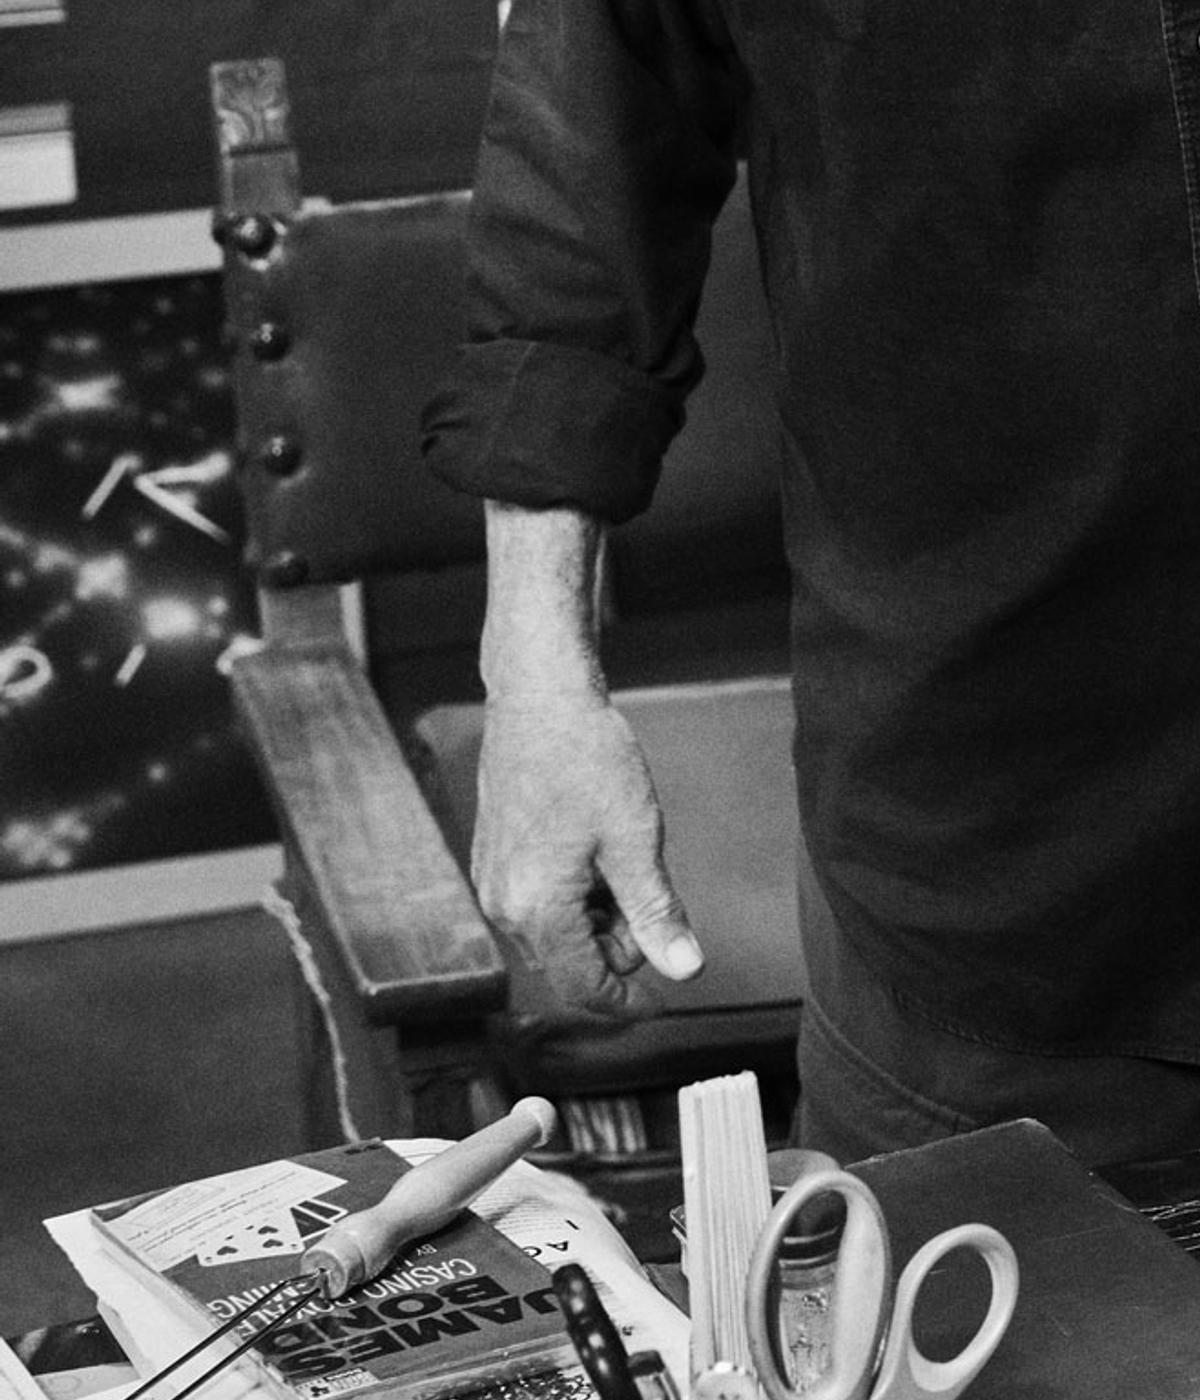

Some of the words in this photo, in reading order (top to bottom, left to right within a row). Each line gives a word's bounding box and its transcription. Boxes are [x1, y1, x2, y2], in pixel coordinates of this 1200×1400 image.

[251, 1275, 509, 1355] BOND
[362, 1257, 477, 1300] CASINO
[277, 1287, 559, 1379] JAMES
